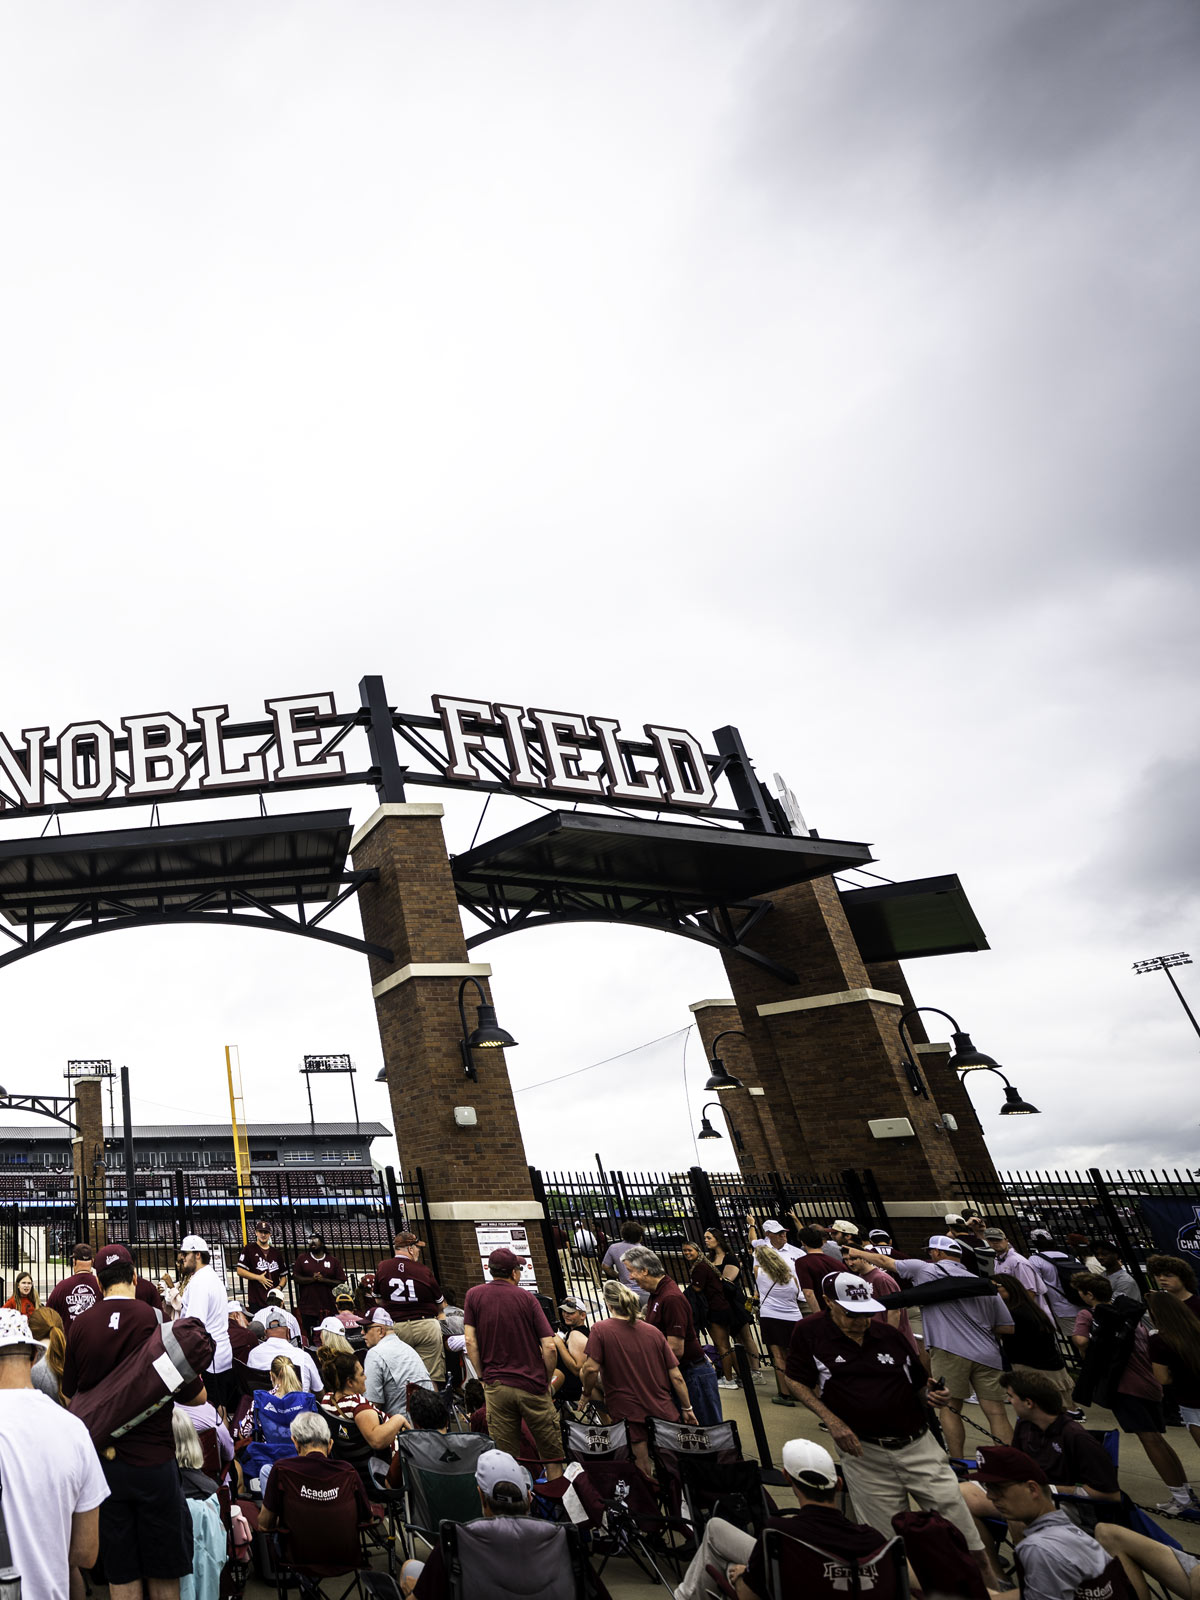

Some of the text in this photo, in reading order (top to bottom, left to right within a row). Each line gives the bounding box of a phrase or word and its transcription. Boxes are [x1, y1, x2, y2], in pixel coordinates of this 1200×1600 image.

[431, 694, 717, 808] FIELD
[388, 1278, 418, 1302] 21
[300, 1485, 340, 1498] Academy
